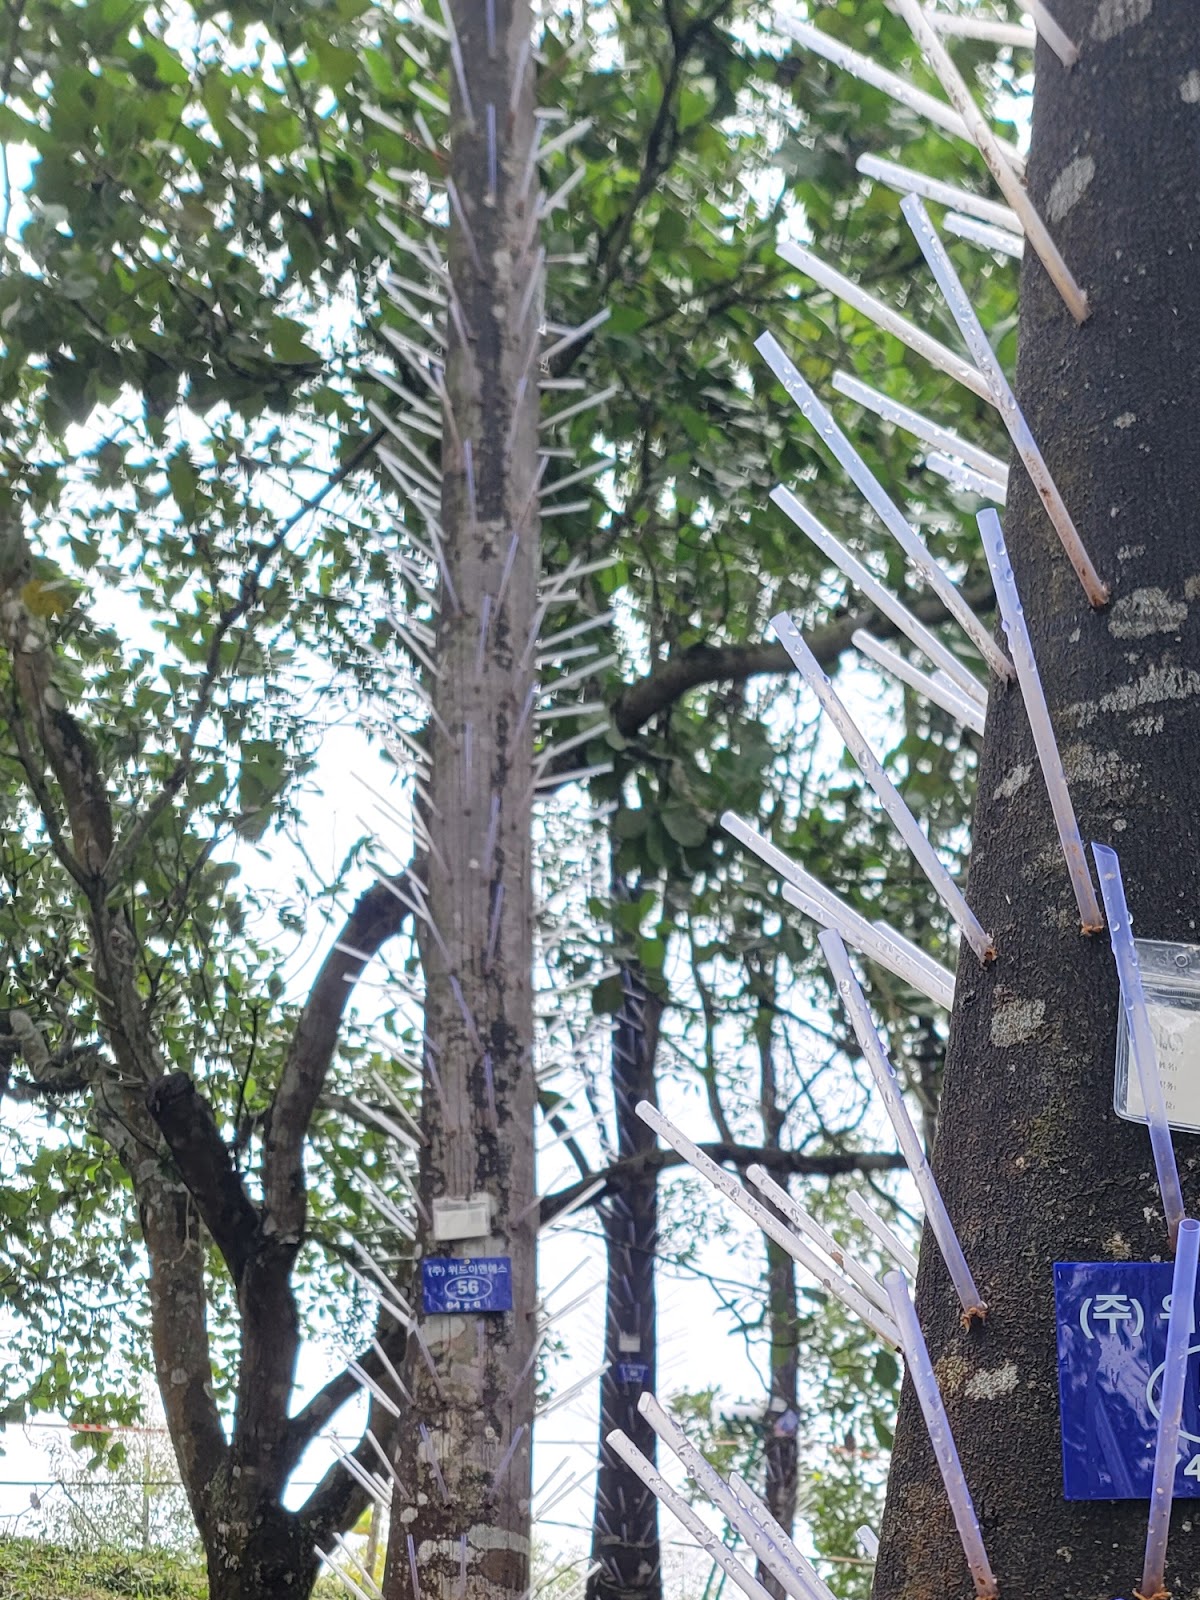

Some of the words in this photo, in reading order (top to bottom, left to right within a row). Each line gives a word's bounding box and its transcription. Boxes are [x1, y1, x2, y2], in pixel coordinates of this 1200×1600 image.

[428, 1265, 445, 1277] (주)
[457, 1280, 479, 1295] 56
[1079, 1294, 1144, 1339] (주)
